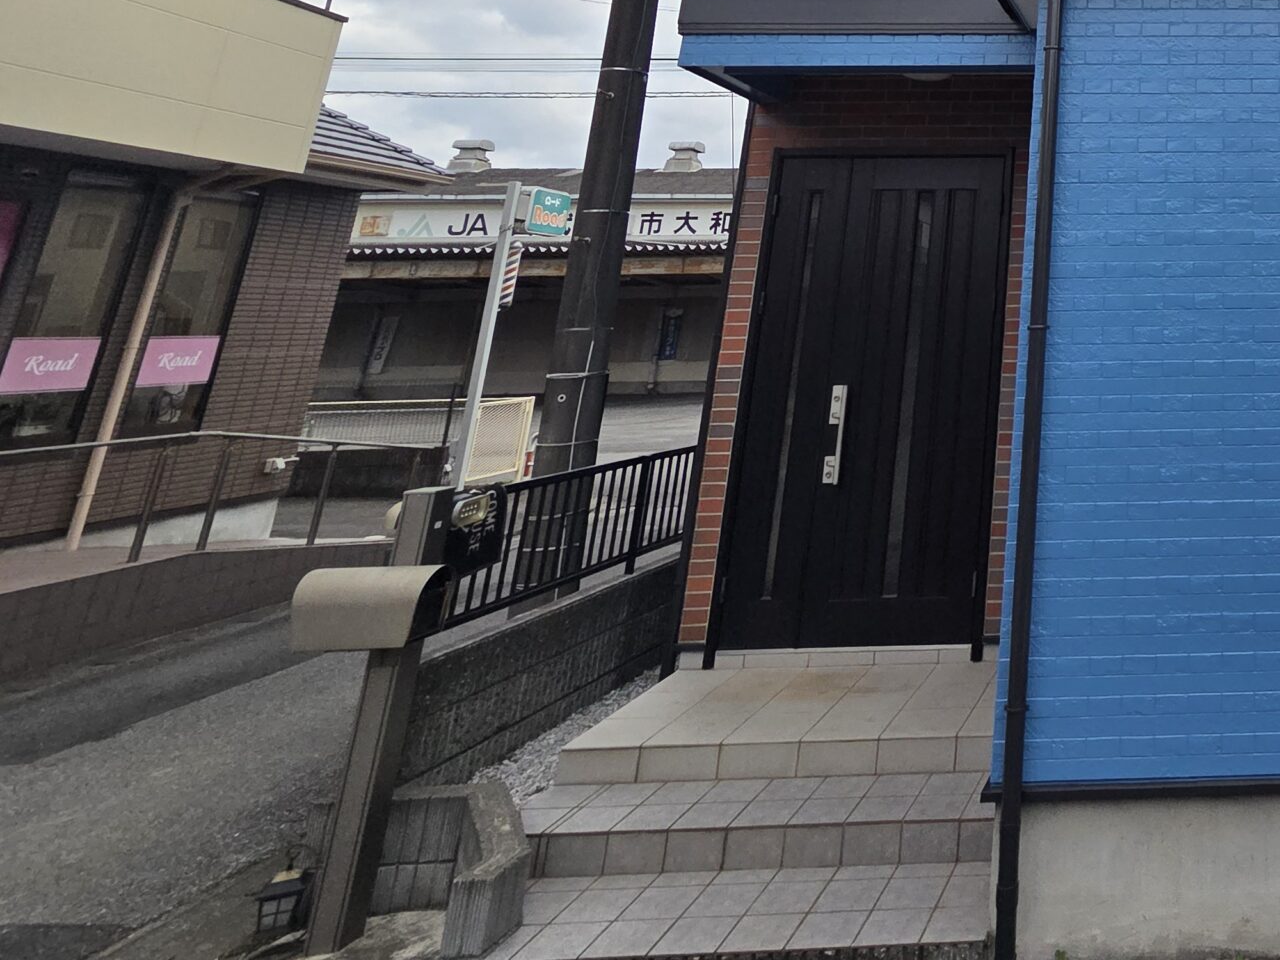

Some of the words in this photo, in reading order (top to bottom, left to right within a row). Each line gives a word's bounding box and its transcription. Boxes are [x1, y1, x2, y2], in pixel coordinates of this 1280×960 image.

[447, 213, 488, 236] JA
[531, 204, 567, 228] Road
[24, 353, 79, 376] Road
[158, 350, 202, 371] Road
